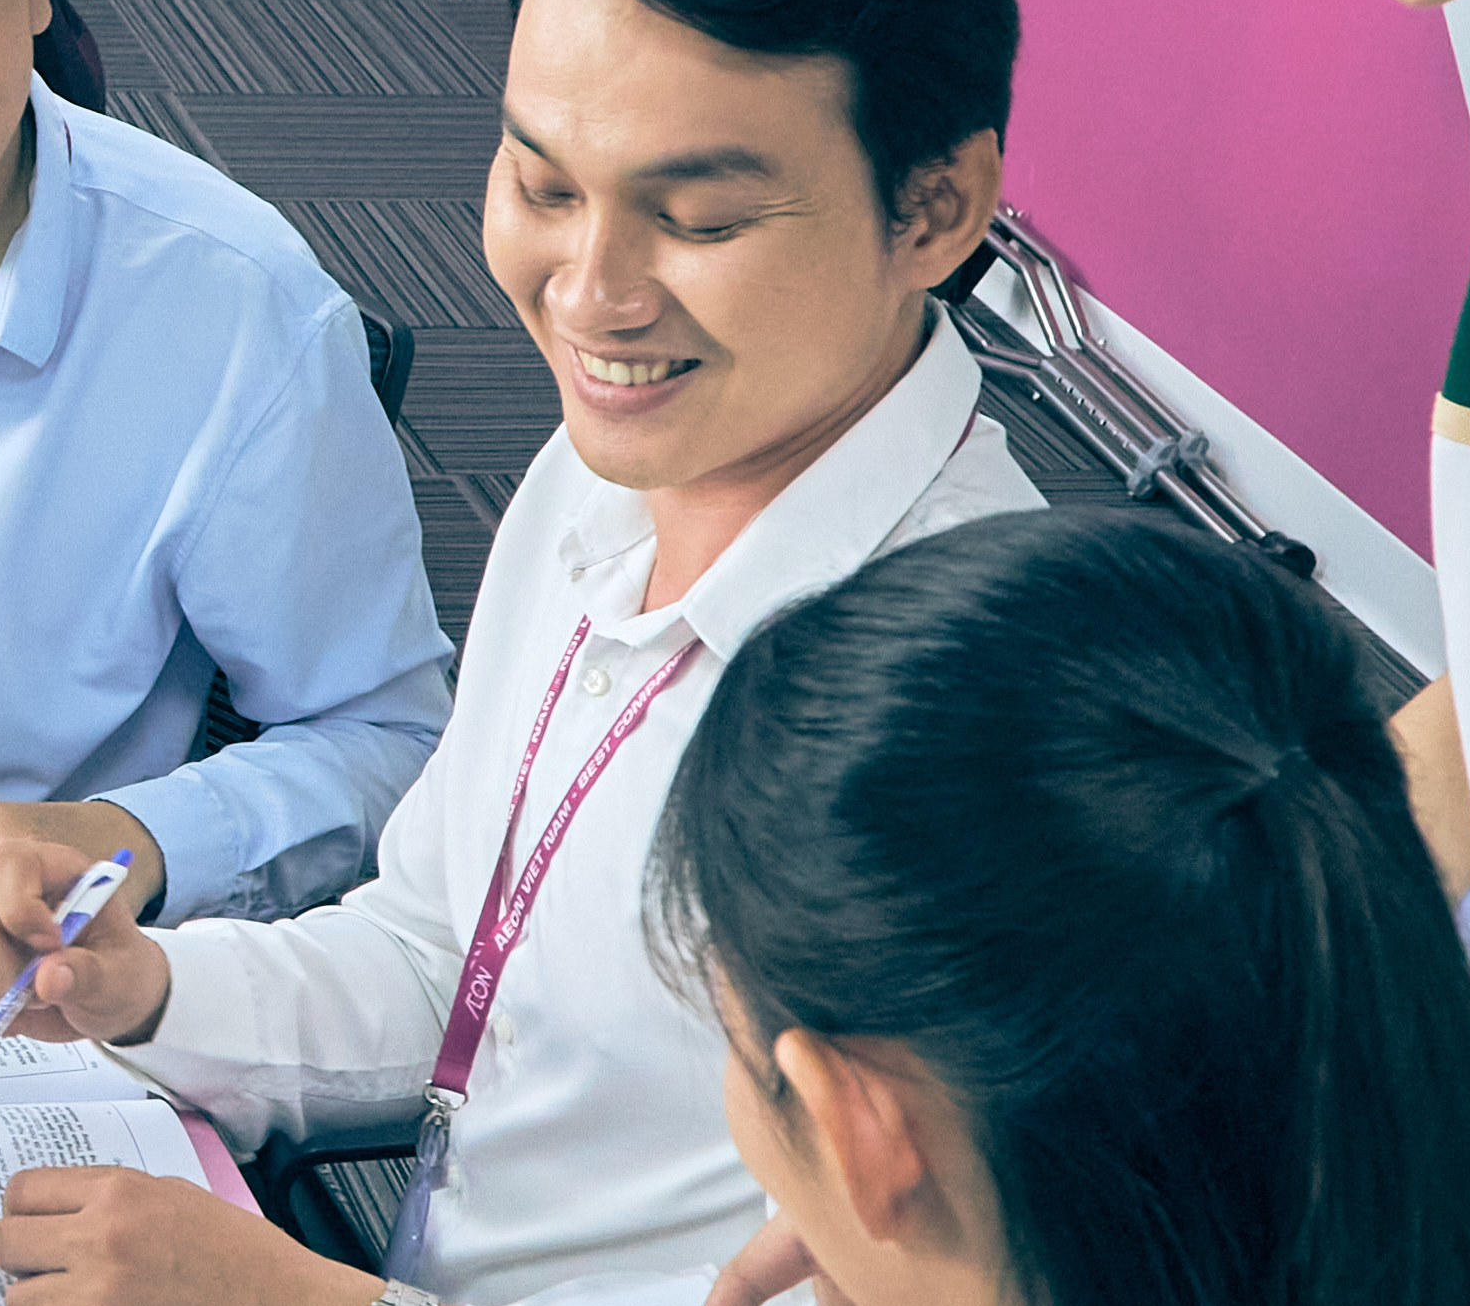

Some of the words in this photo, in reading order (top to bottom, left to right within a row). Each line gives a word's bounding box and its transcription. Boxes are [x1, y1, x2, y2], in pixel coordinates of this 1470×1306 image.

[493, 896, 526, 952] AEON
[517, 846, 545, 895] VIET
[541, 799, 573, 852] NAM
[575, 735, 613, 791] BEST
[611, 654, 682, 739] COMPAN
